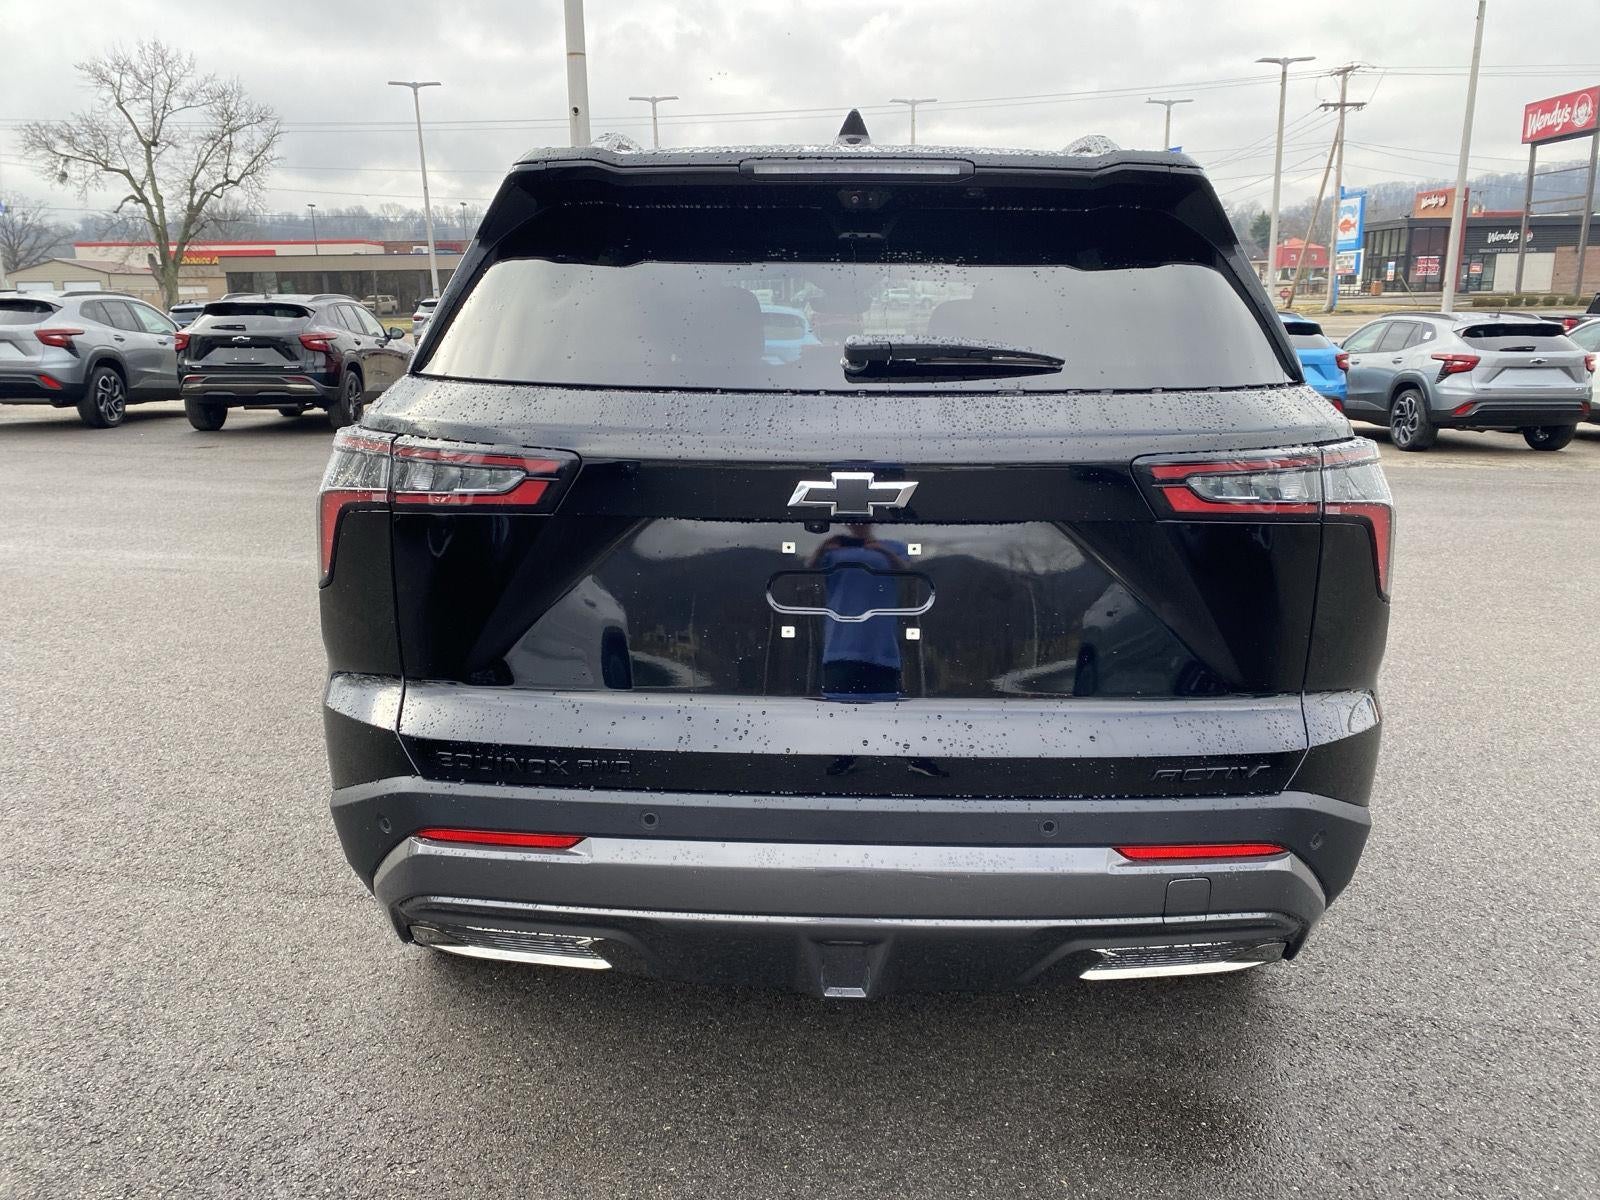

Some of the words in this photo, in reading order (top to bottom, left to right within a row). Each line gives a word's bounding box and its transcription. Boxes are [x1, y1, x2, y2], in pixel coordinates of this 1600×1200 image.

[1527, 101, 1571, 138] Wendy's
[1487, 230, 1520, 243] Wendy's
[436, 752, 568, 775] EQUINOX
[1152, 765, 1271, 782] ACTIV
